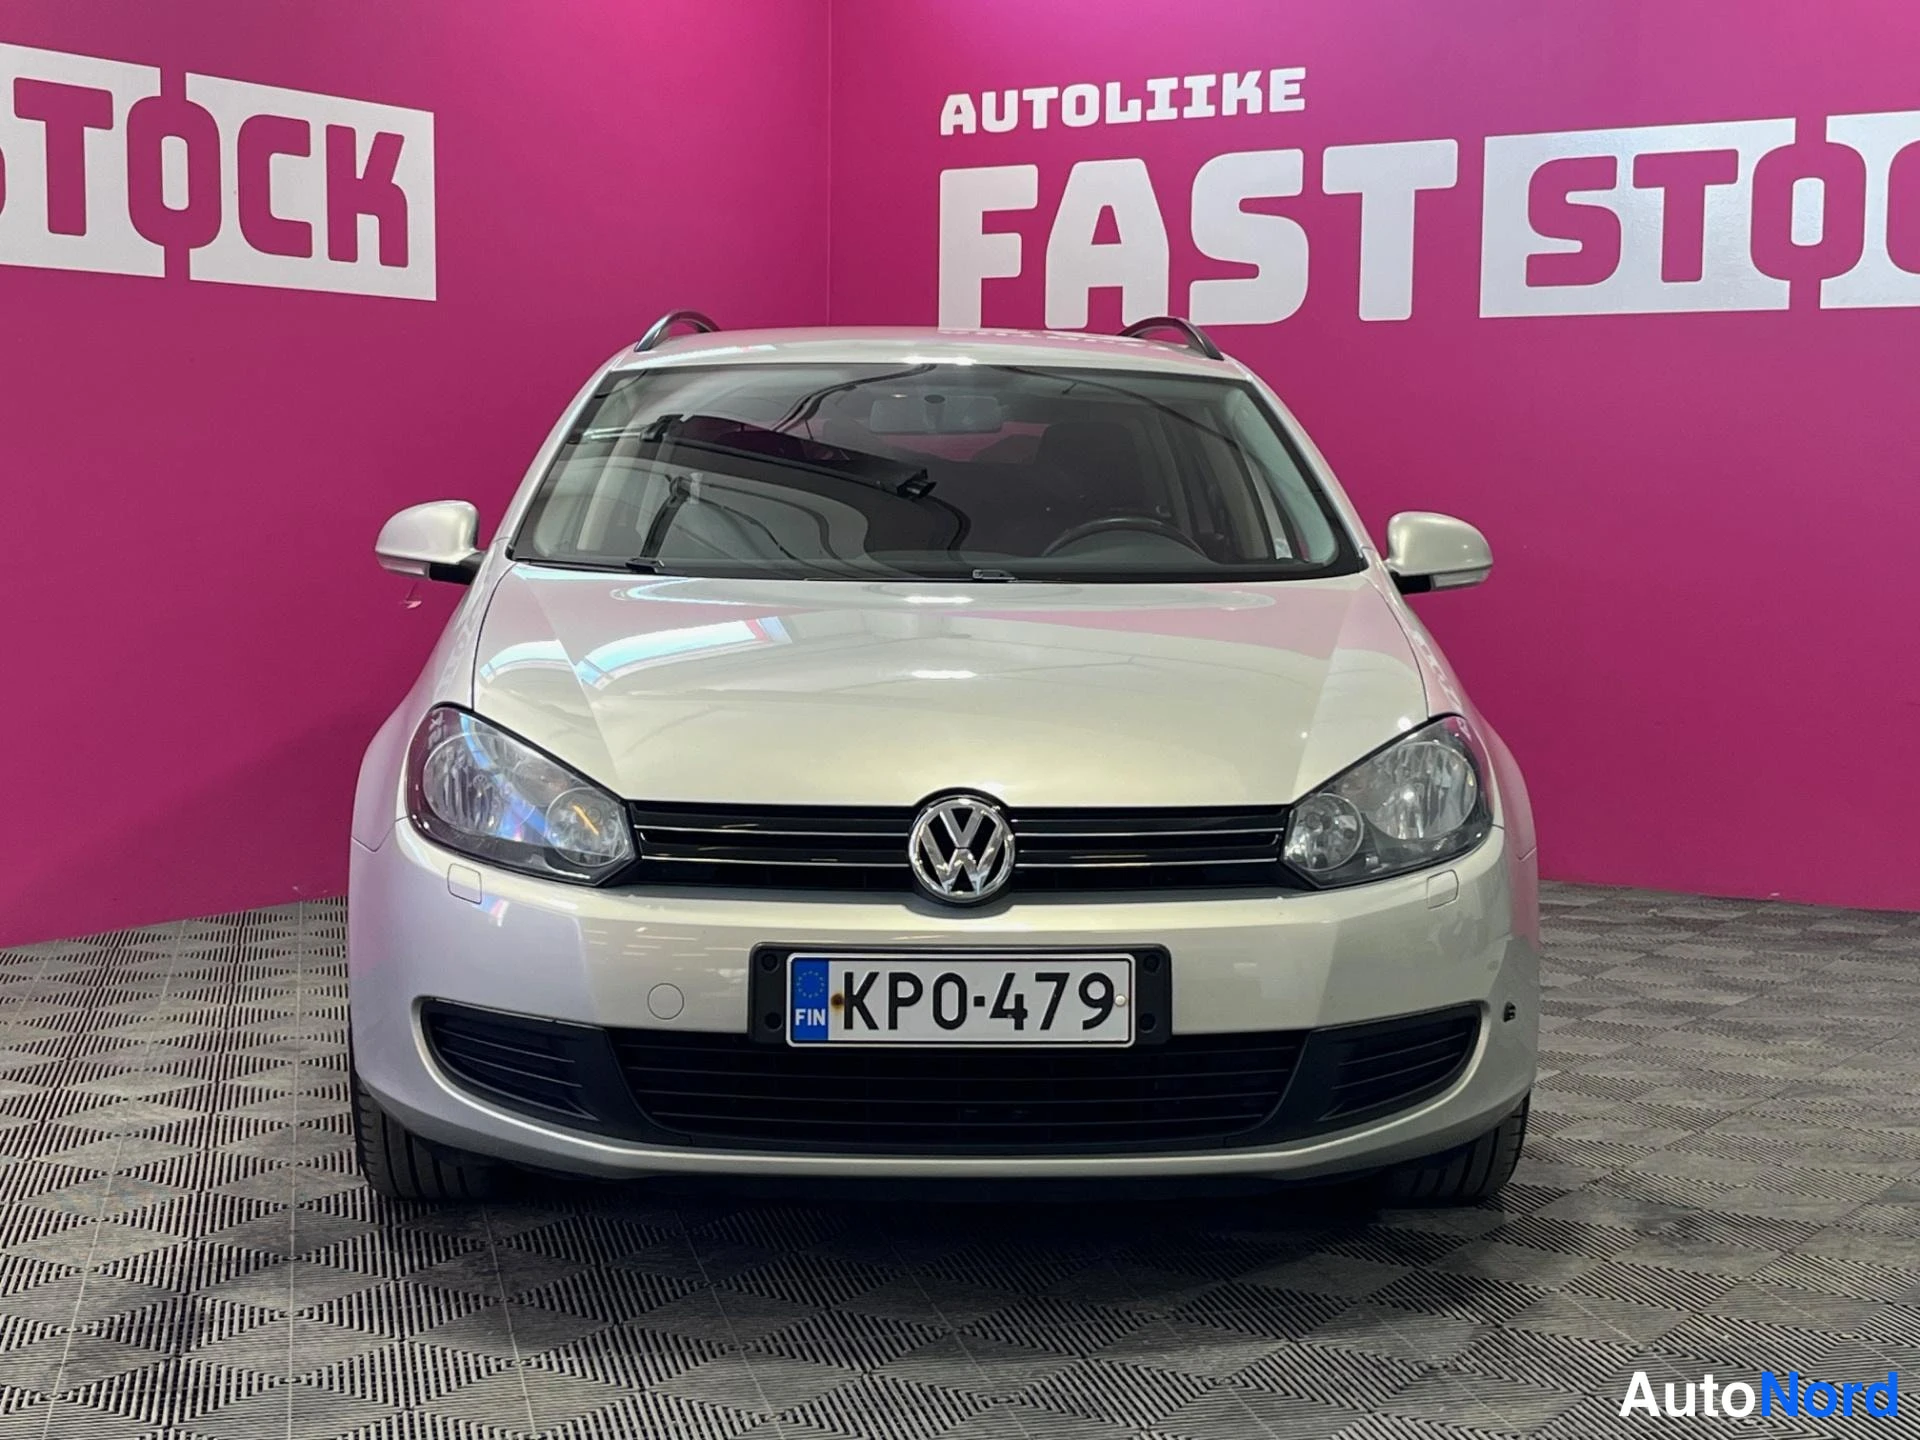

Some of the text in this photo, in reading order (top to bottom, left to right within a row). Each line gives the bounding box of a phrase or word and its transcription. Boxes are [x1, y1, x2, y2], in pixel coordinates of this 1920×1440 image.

[940, 67, 1306, 136] AUTOLIIKE
[0, 76, 409, 269] TOCK
[913, 800, 1009, 898] VW
[795, 1008, 827, 1027] FIN
[843, 971, 1115, 1031] KPO-479
